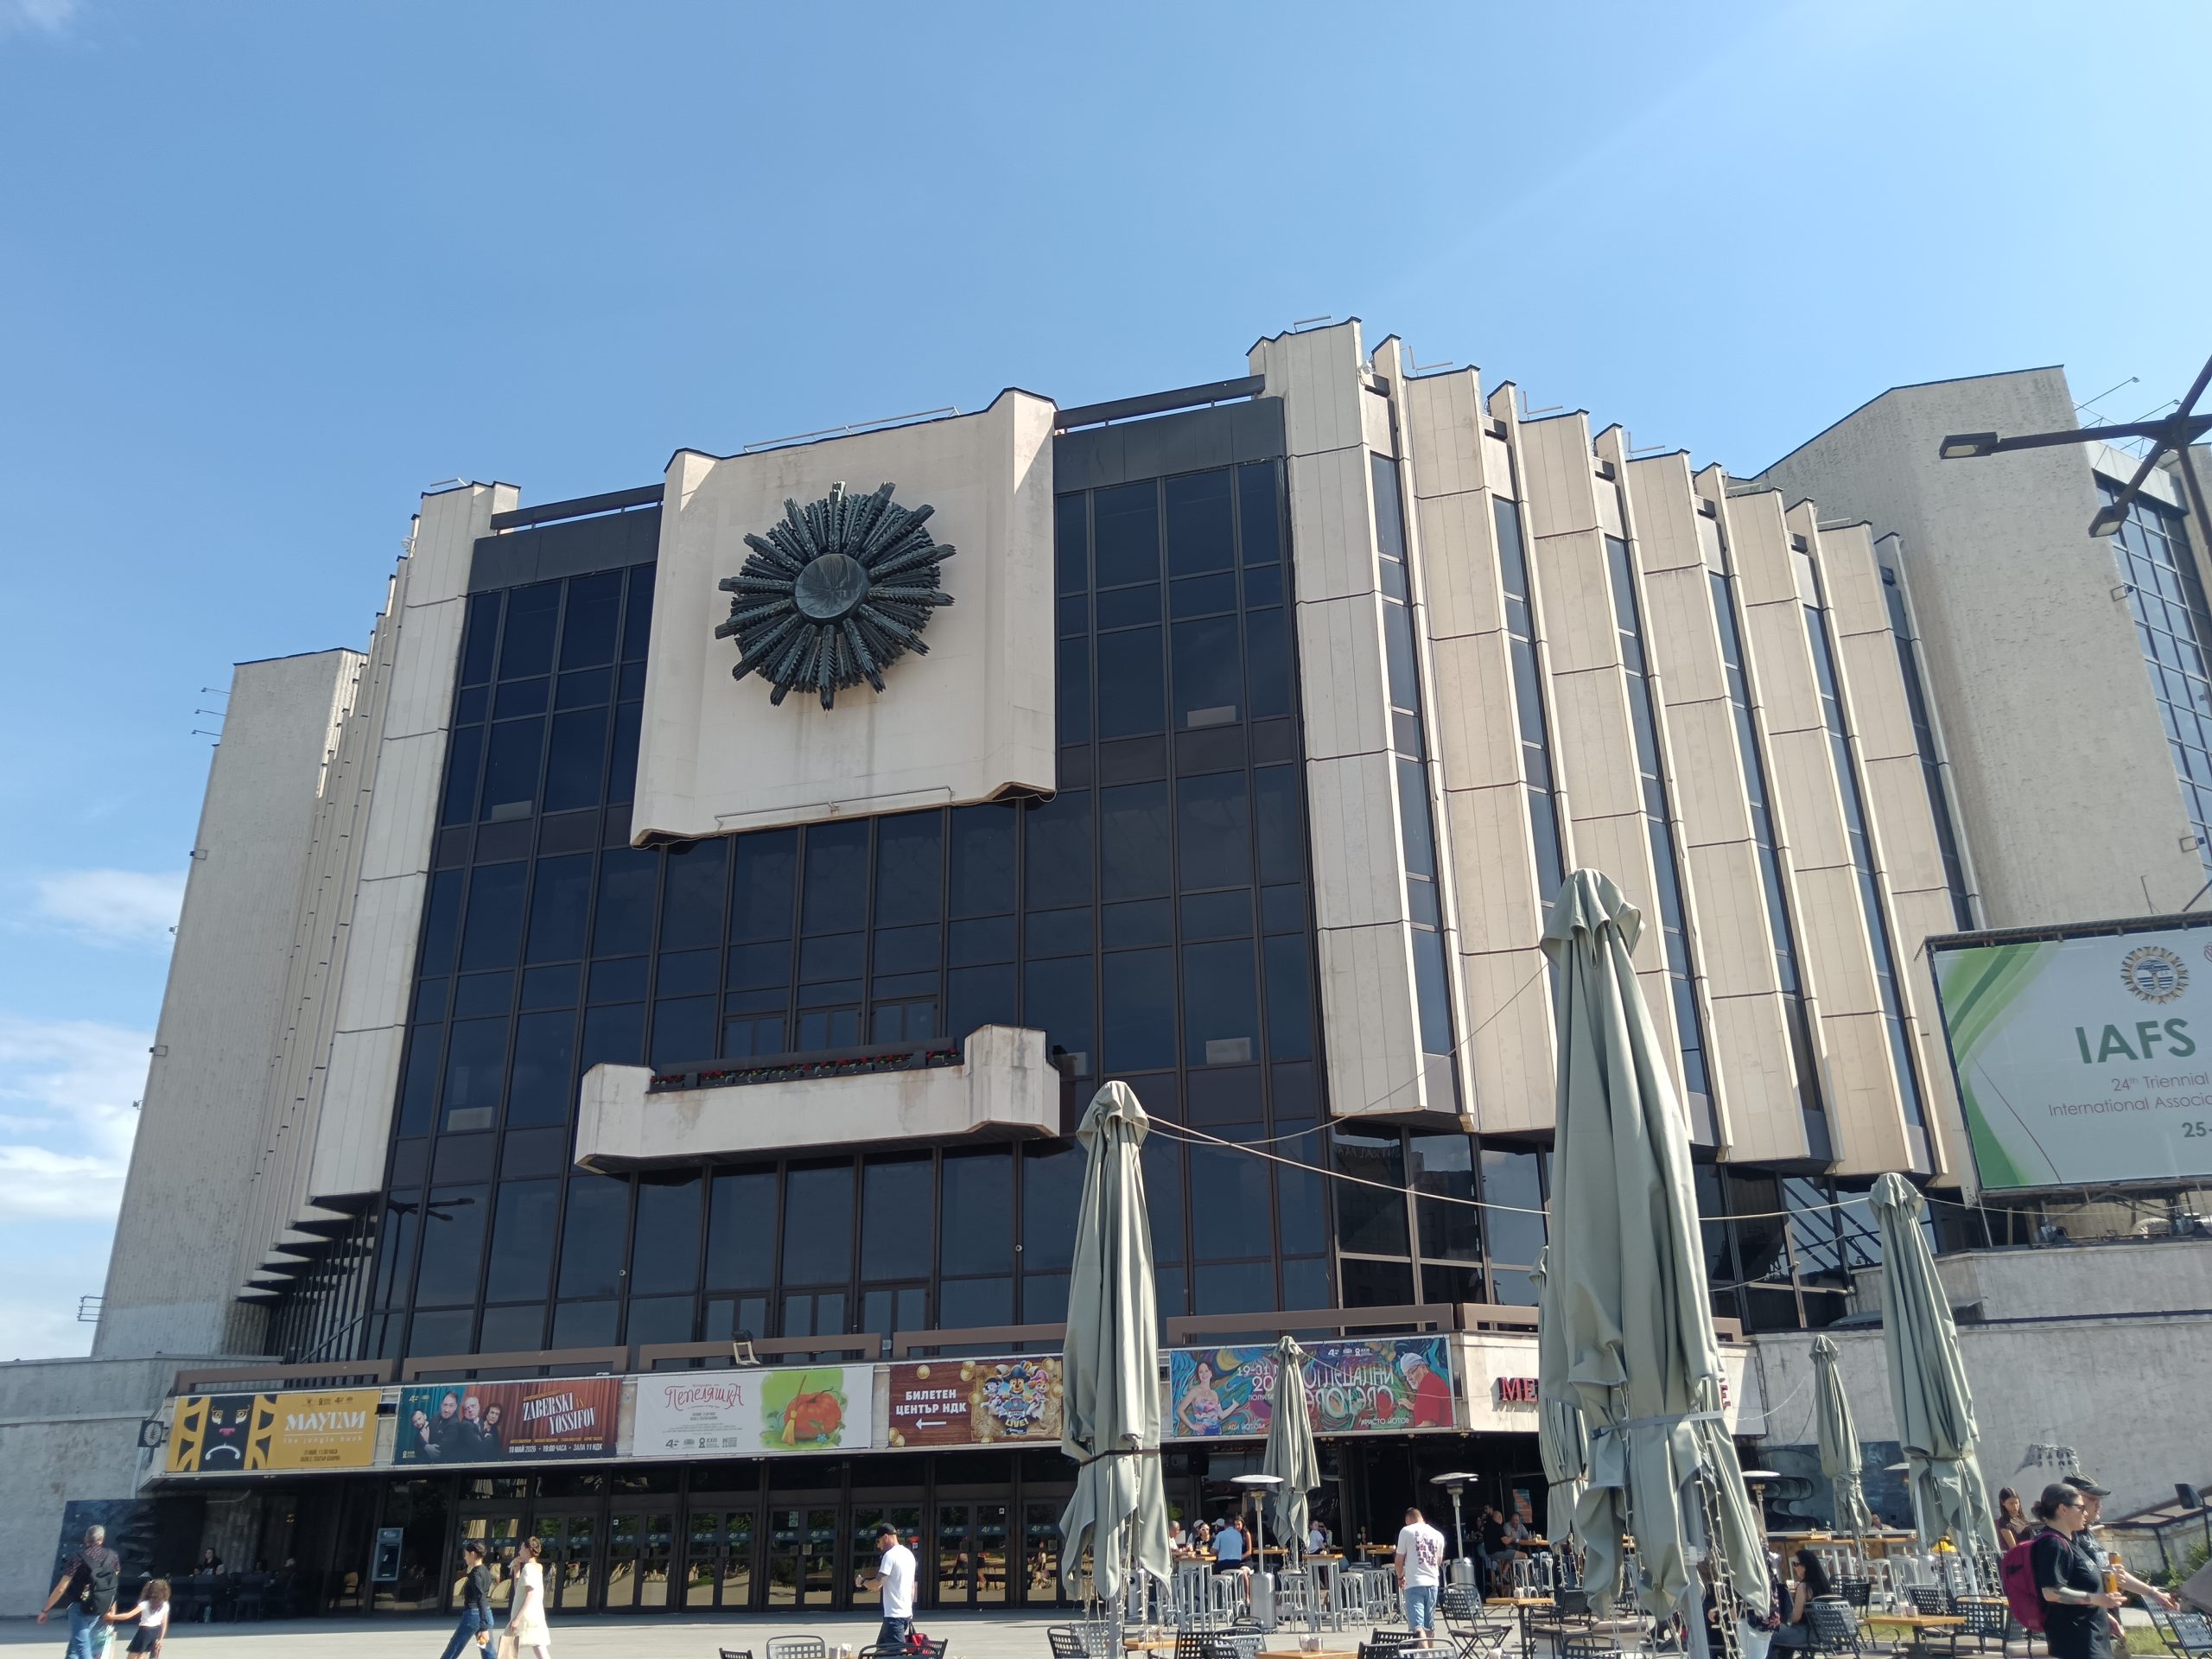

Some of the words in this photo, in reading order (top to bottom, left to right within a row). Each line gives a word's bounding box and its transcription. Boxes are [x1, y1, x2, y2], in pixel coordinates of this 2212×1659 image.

[2075, 1018, 2196, 1064] IAFS
[2143, 1071, 2209, 1089] Triennial
[2049, 1096, 2150, 1116] International
[1236, 1364, 1269, 1376] 19-31
[1252, 1375, 1277, 1391] 20
[906, 1389, 957, 1401] БИЛЕТЕН
[523, 1392, 573, 1421] ZABERSKI
[896, 1403, 939, 1416] ЦЕНТЪР
[943, 1402, 967, 1414] НДК
[284, 1410, 366, 1431] МАУГЛИ
[549, 1407, 595, 1435] YOSSIFOV
[304, 1437, 334, 1446] jungle
